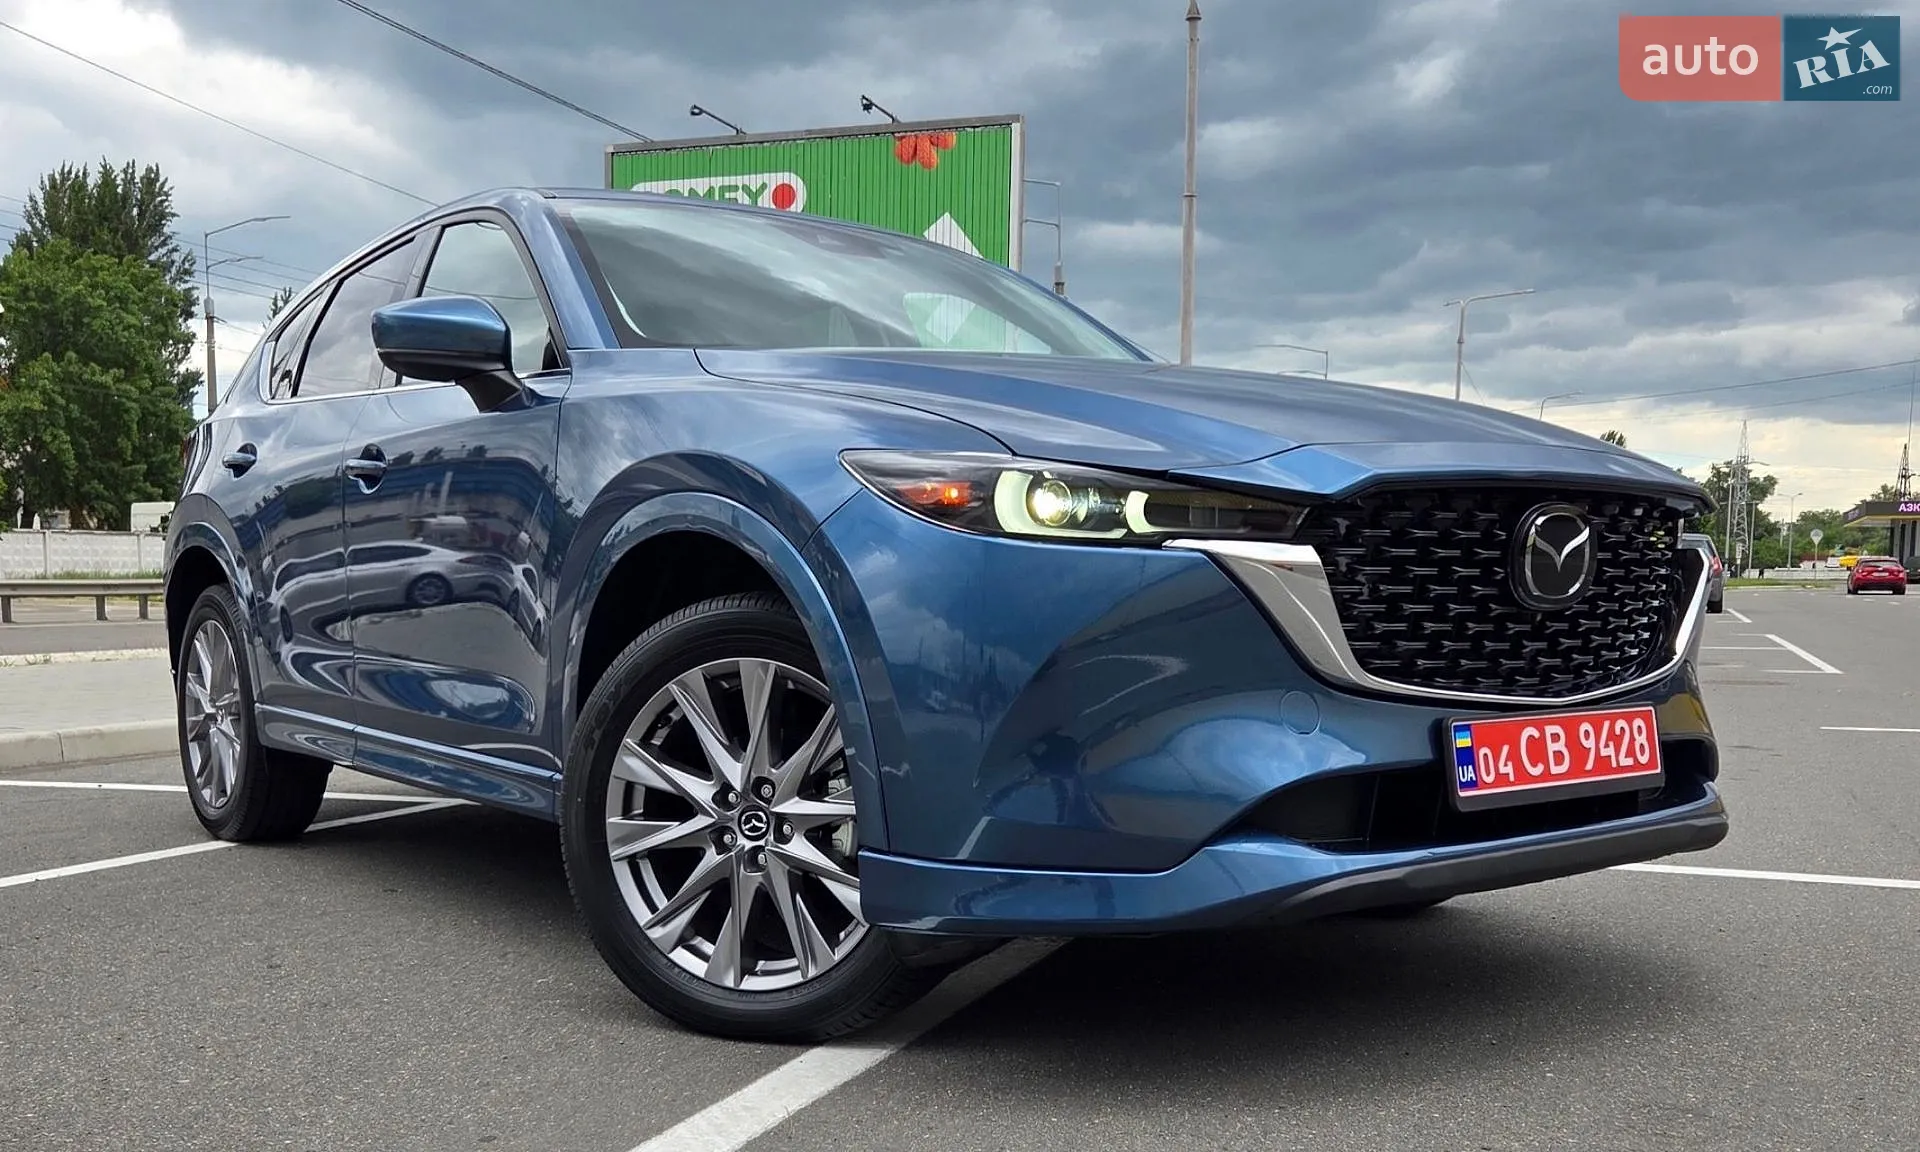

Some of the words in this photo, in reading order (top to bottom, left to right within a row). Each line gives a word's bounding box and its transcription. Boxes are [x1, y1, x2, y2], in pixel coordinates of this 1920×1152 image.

[1478, 745, 1515, 784] 04
[1520, 725, 1571, 776] CB
[1579, 717, 1650, 771] 9428
[1459, 766, 1476, 782] UA
